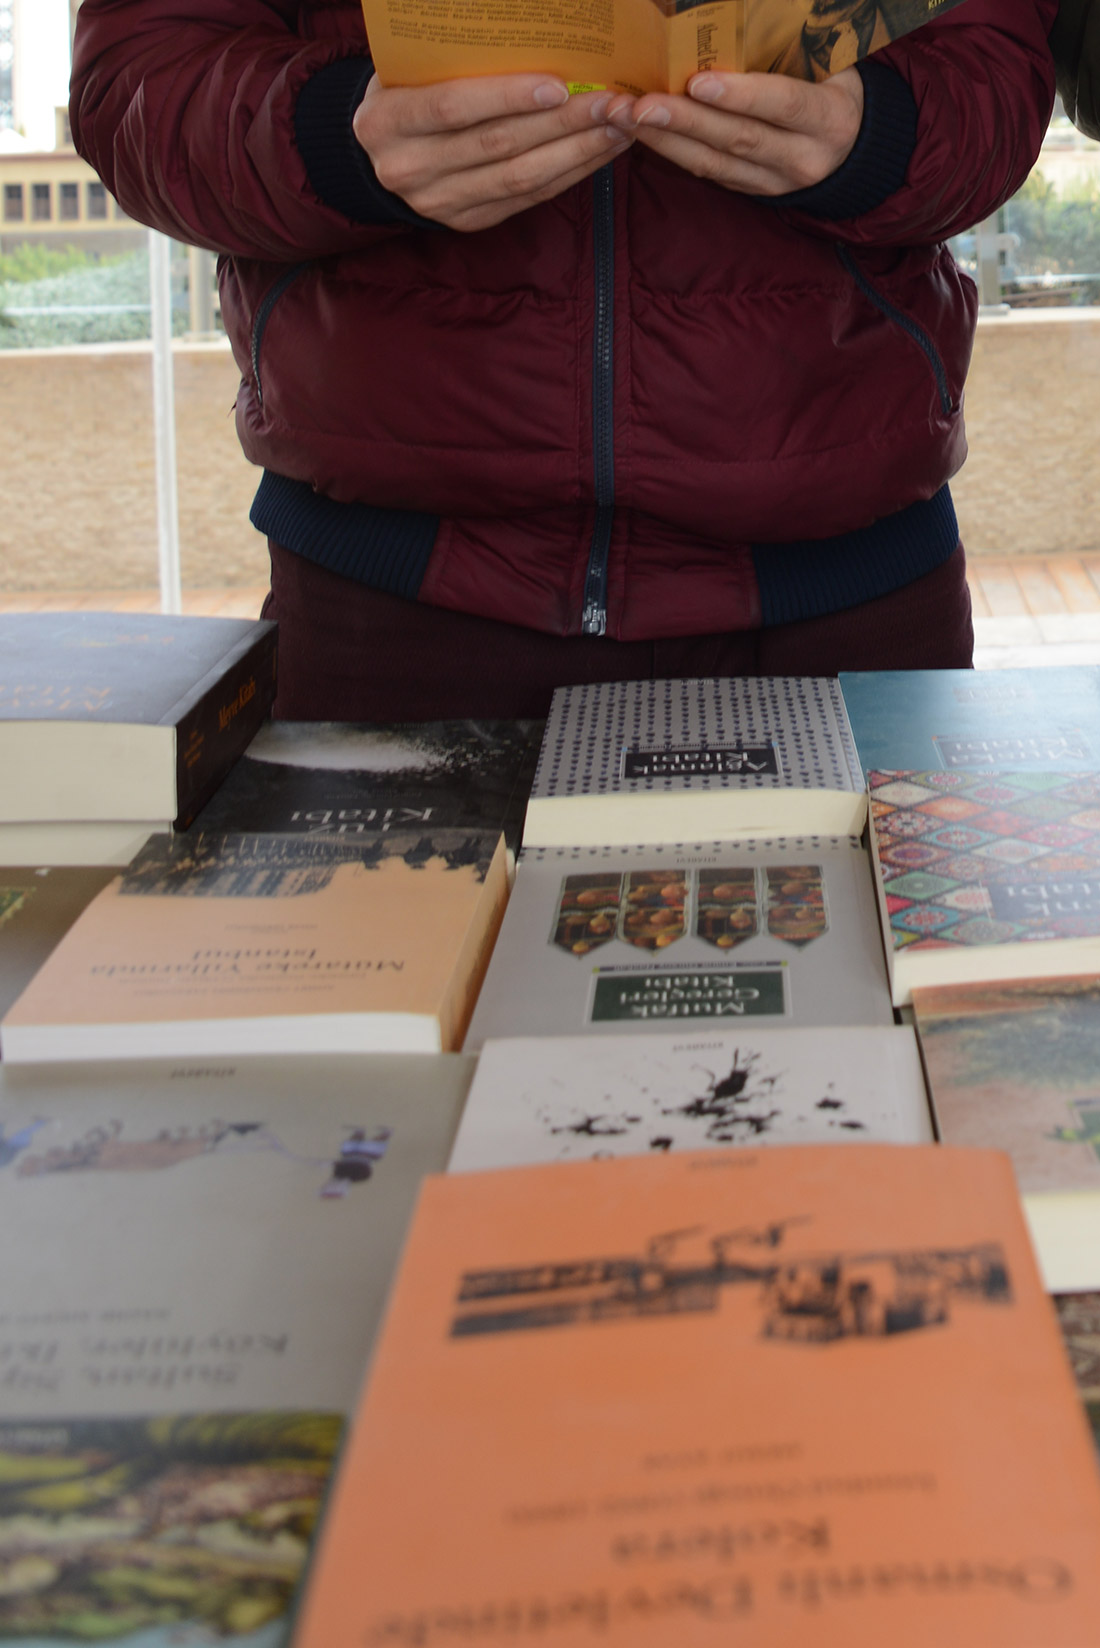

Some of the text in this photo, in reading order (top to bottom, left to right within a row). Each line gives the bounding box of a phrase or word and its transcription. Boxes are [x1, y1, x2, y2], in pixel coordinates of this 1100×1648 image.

[290, 807, 435, 824] Kitabı
[644, 975, 735, 989] Kitabı
[619, 987, 760, 1005] Gereçleri
[630, 1001, 745, 1019] Mutfak
[609, 1516, 829, 1567] Kolera
[775, 1556, 1077, 1616] Osmanlı
